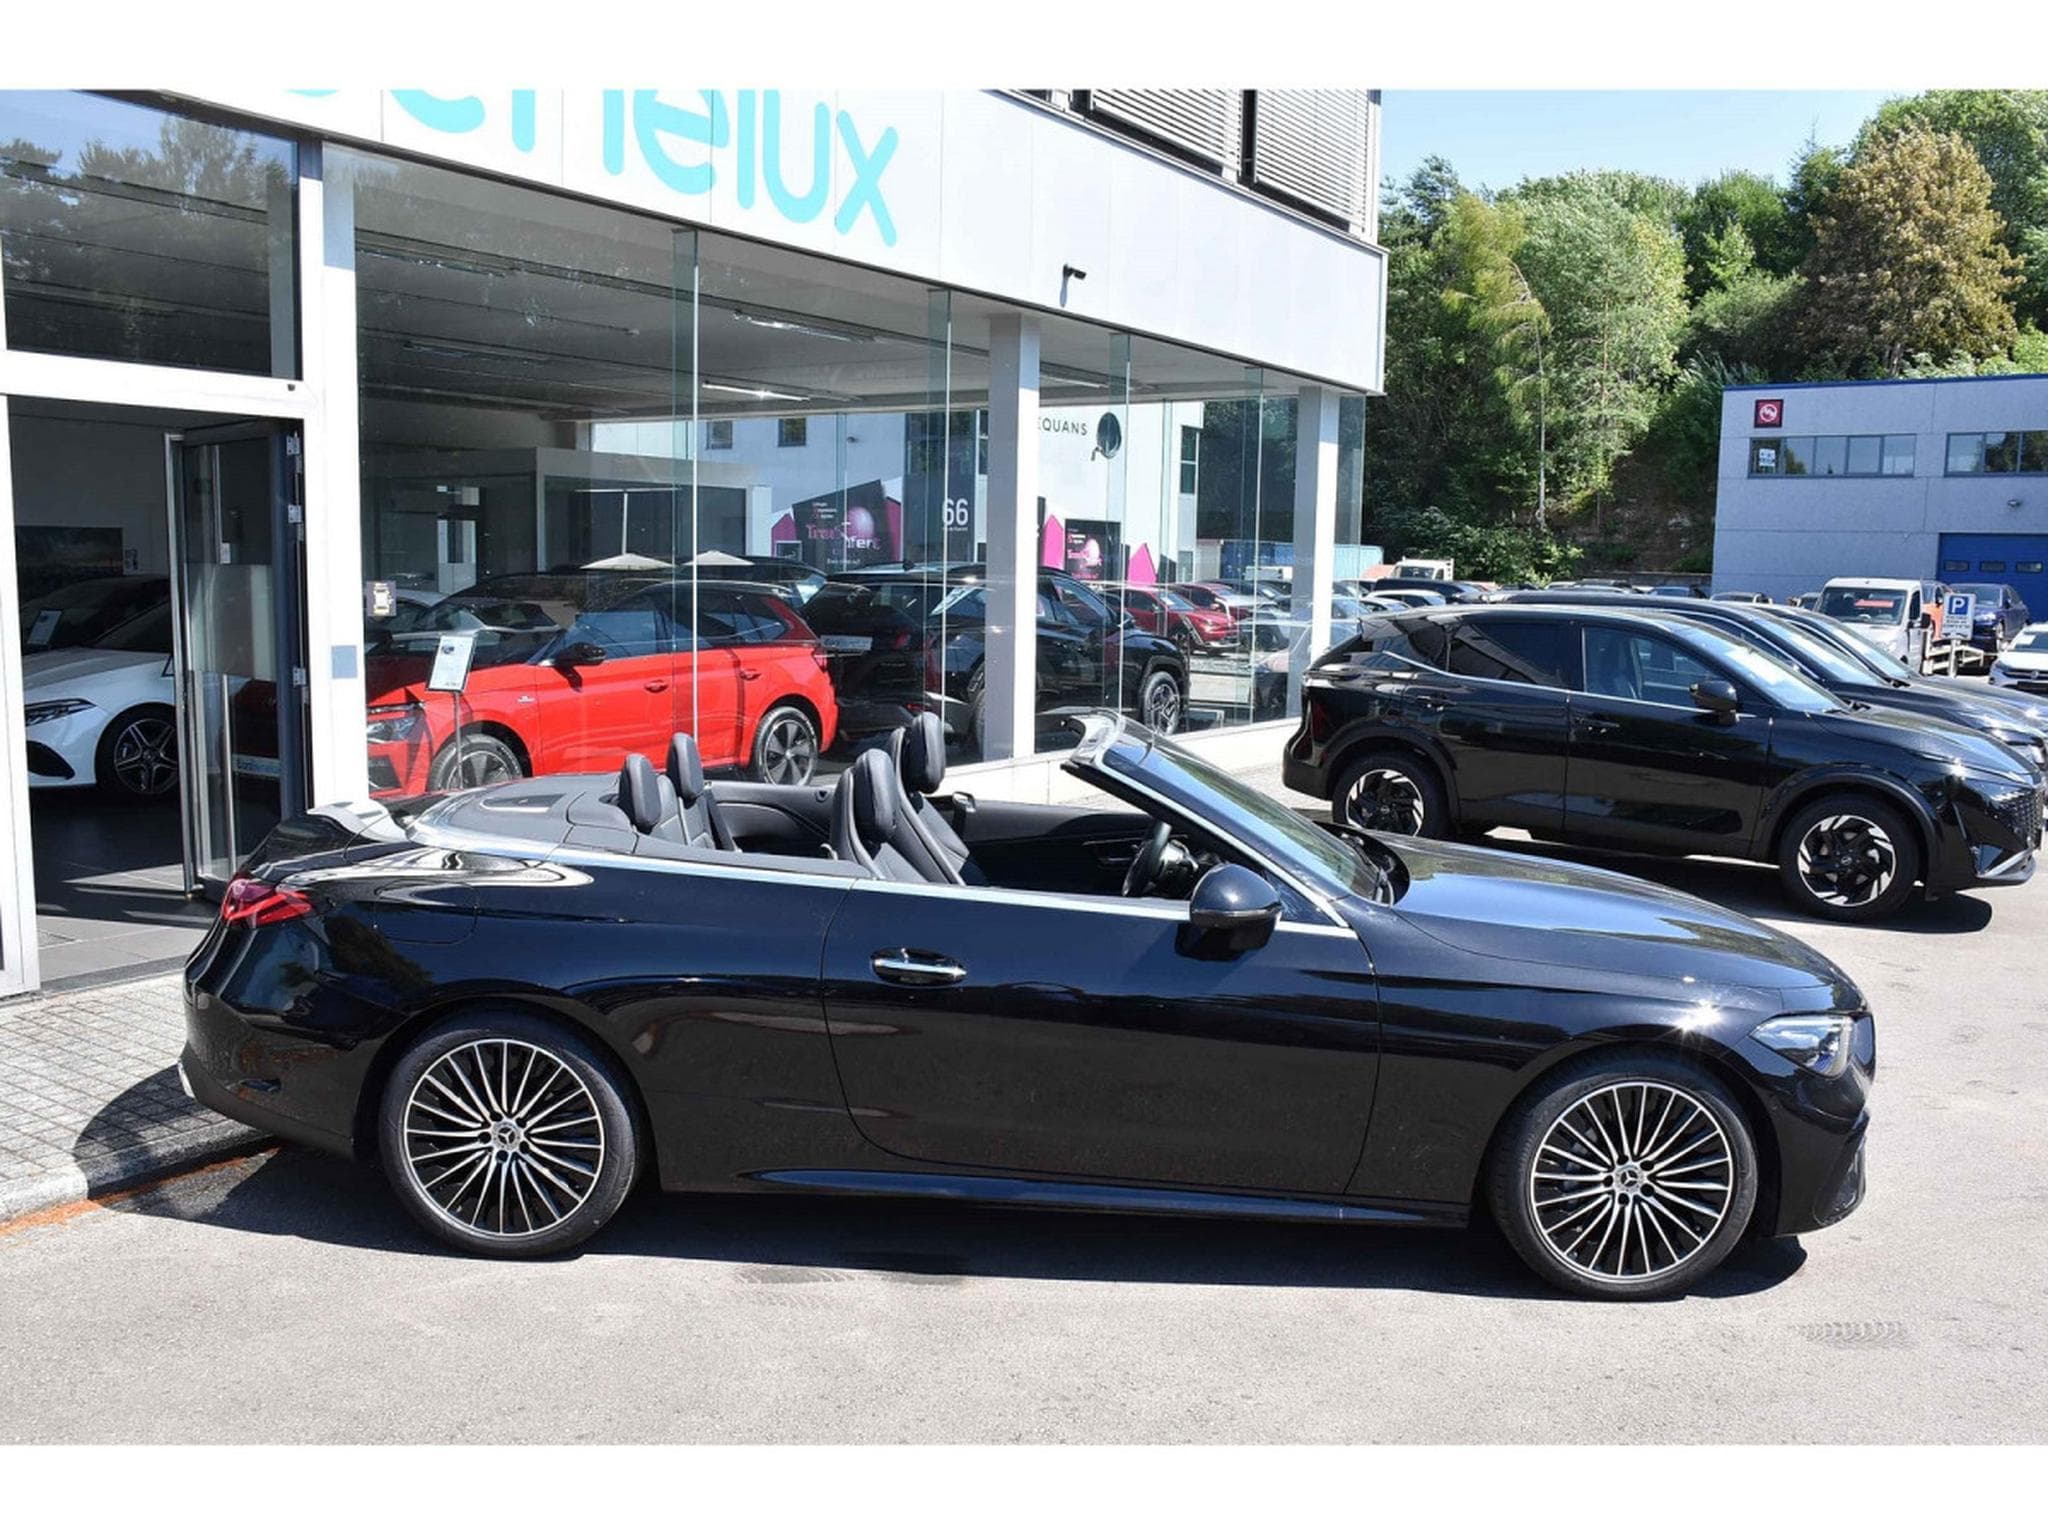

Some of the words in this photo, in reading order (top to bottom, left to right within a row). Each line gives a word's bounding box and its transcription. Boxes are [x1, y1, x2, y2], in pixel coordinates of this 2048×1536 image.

[1038, 417, 1088, 436] QUANS
[942, 498, 969, 526] 66
[1952, 597, 1965, 613] P
